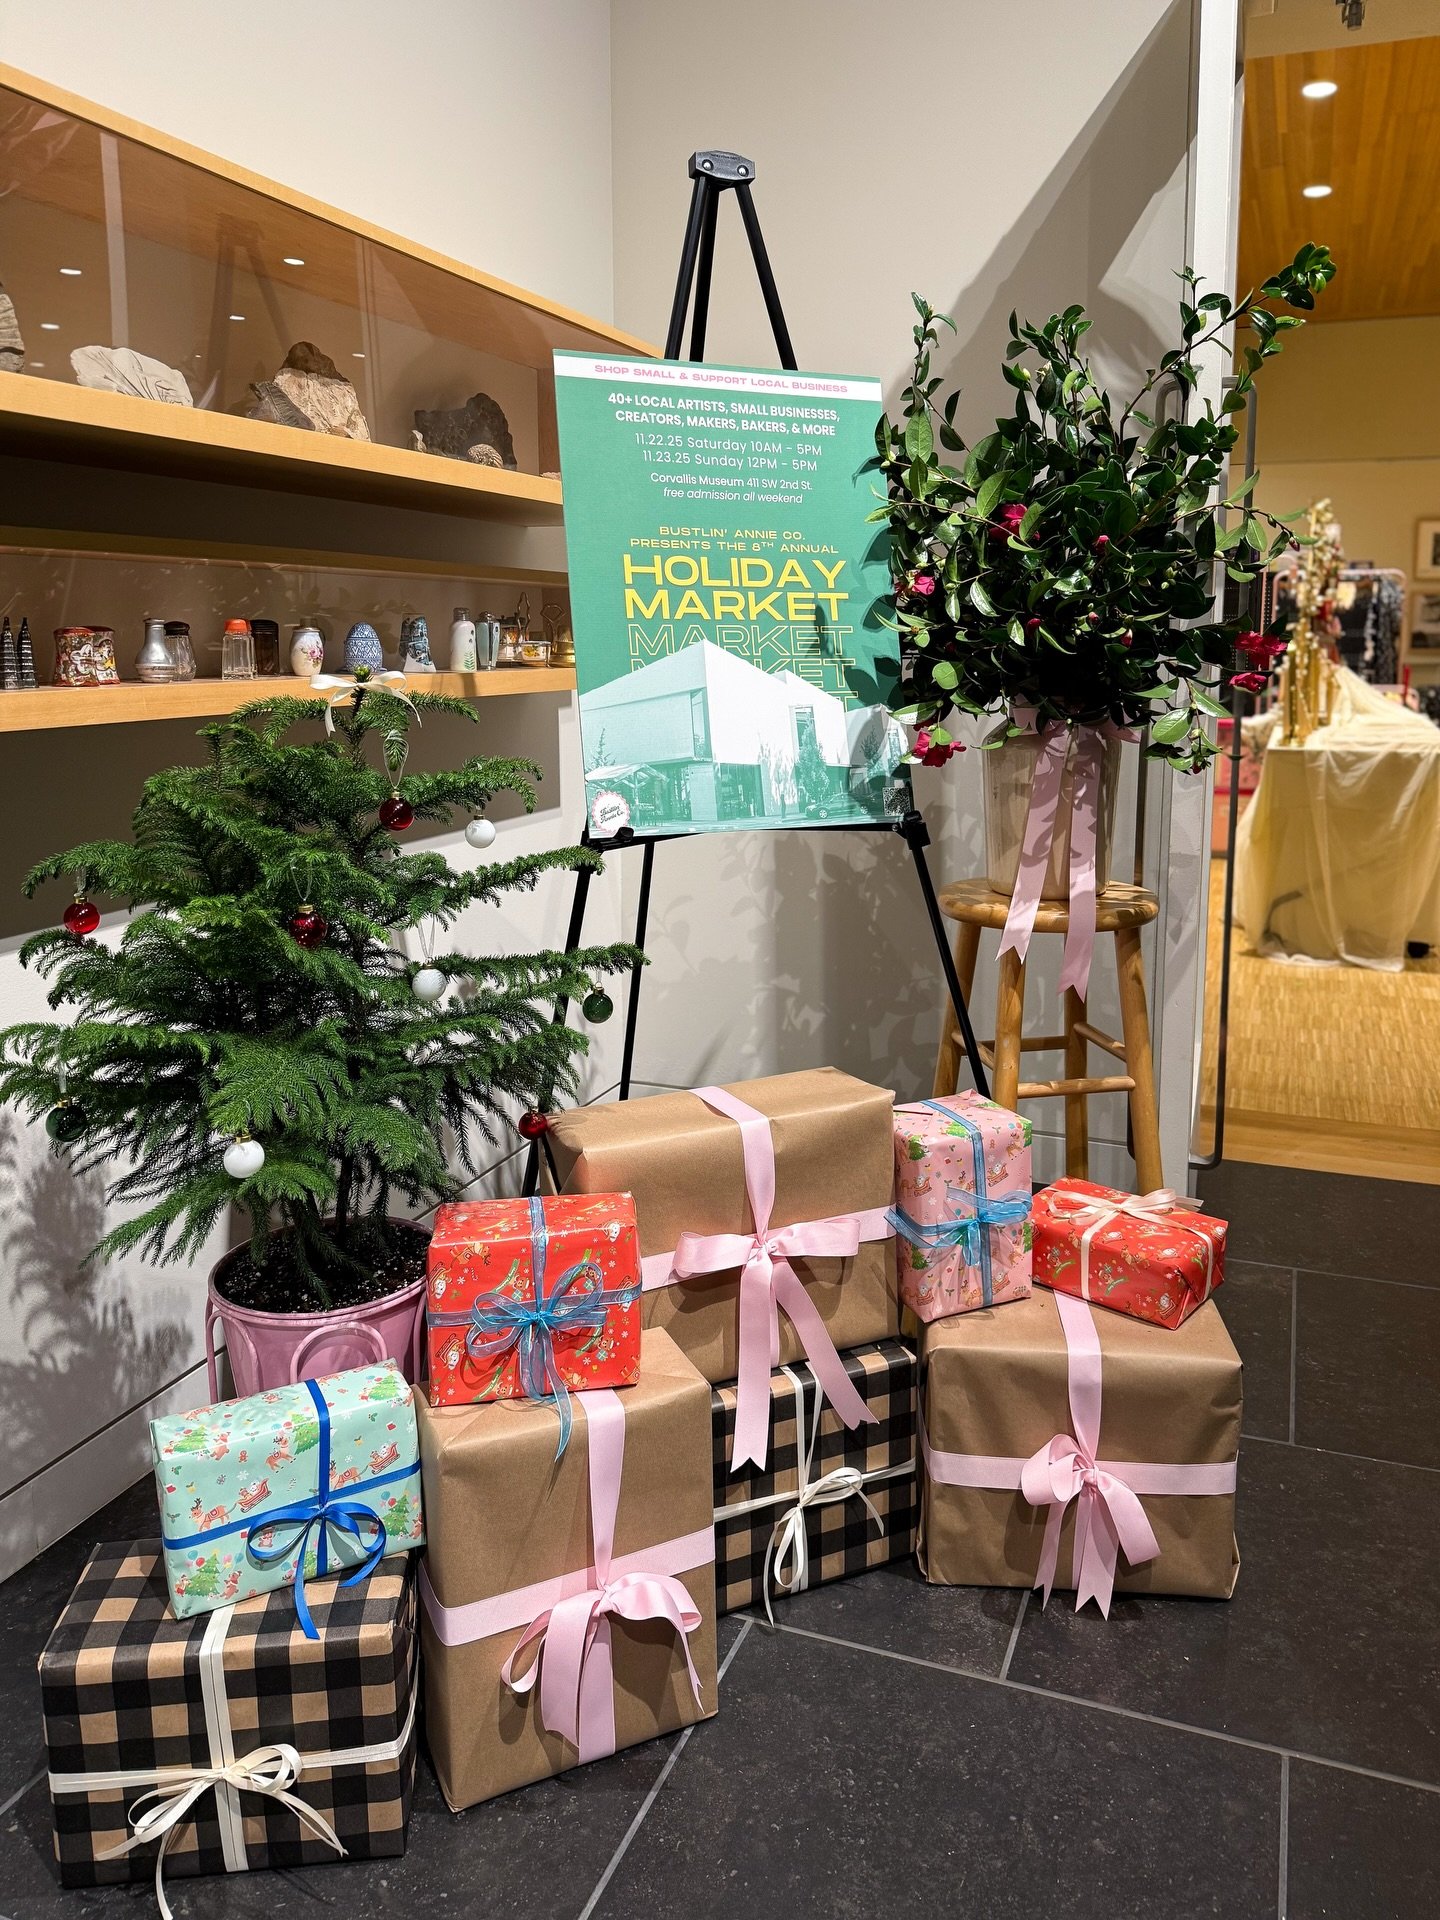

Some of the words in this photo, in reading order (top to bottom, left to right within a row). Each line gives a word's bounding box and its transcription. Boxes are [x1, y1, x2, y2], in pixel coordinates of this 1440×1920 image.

[595, 365, 629, 375] SHOP
[633, 368, 675, 379] SMALL
[679, 372, 688, 380] &
[692, 373, 747, 385] SUPPORT
[751, 378, 789, 389] LOCAL
[792, 381, 848, 393] BUSINESS
[608, 392, 632, 405] 40+
[635, 394, 675, 409] LOCAL
[677, 398, 729, 414] ARTISTS,
[730, 402, 768, 416] SMALL
[770, 405, 840, 422] BUSINESSES,
[615, 410, 685, 427] CREATORS,
[686, 415, 739, 431] MAKERS,
[741, 419, 790, 434] BAKERS,
[791, 423, 800, 433] &
[802, 424, 835, 436] MORE
[635, 433, 683, 447] 11.22.25
[687, 437, 746, 454] Saturday
[750, 440, 782, 453] 10AM
[796, 444, 822, 456] 5PM
[643, 450, 690, 464] 11.23.25
[694, 454, 744, 470] Sunday
[747, 457, 777, 469] 12PM
[792, 460, 817, 471] 5PM
[650, 472, 697, 485] Corvallis
[699, 475, 744, 488] Museum
[747, 477, 759, 488] 411
[761, 478, 777, 489] SW
[779, 479, 799, 490] 2nd
[801, 480, 813, 490] St.
[663, 487, 684, 498] free
[686, 488, 740, 501] admission
[743, 491, 755, 501] all
[757, 493, 803, 504] weekend
[659, 526, 728, 538] BUSTLIN'
[734, 529, 777, 539] ANNIE
[782, 531, 806, 541] CO.
[630, 538, 711, 550] PRESENTS
[716, 541, 746, 551] THE
[780, 543, 839, 554] ANNUAL
[623, 553, 847, 589] HOLIDAY
[624, 588, 849, 622] MARKET
